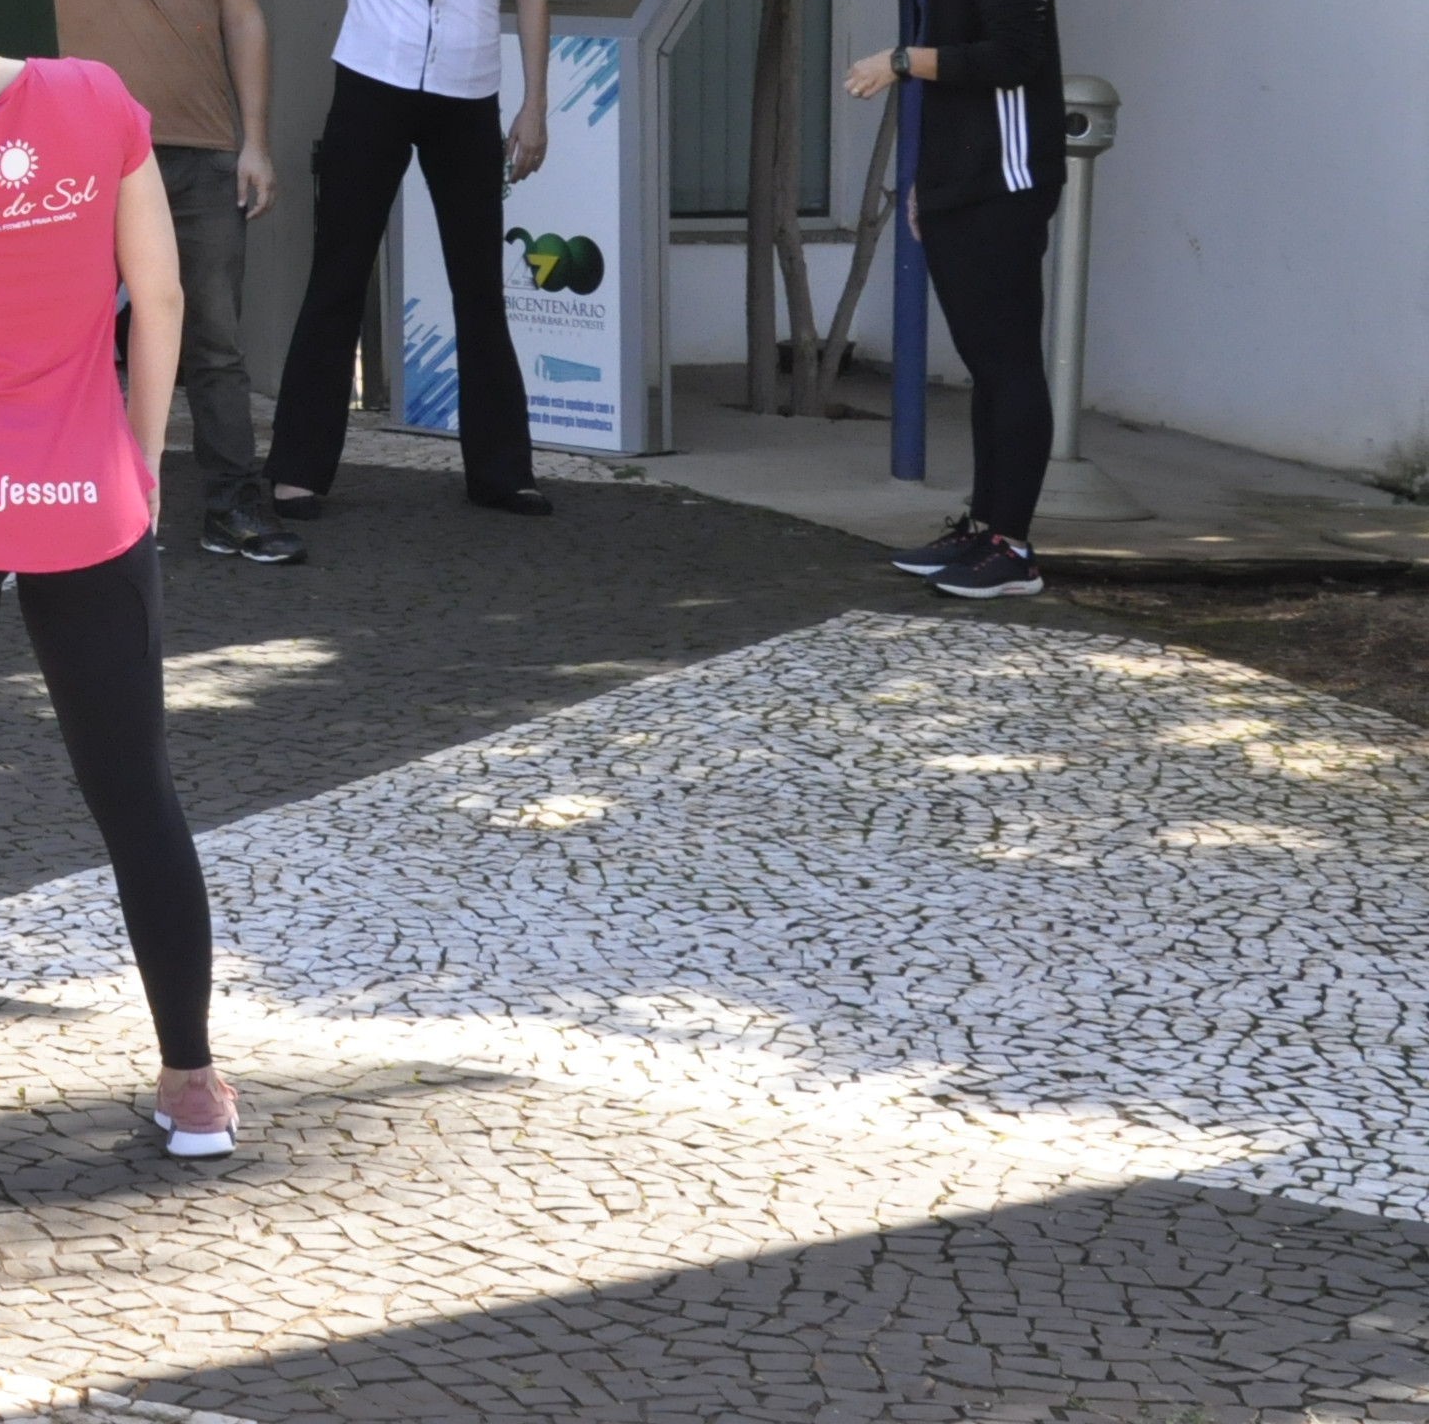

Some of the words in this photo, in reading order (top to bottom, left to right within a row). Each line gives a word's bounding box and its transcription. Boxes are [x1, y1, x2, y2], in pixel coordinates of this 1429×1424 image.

[2, 192, 37, 219] do
[42, 175, 99, 211] Sol
[2, 219, 31, 232] FITNESS
[53, 211, 78, 224] DANÇA
[508, 313, 529, 323] ANTA
